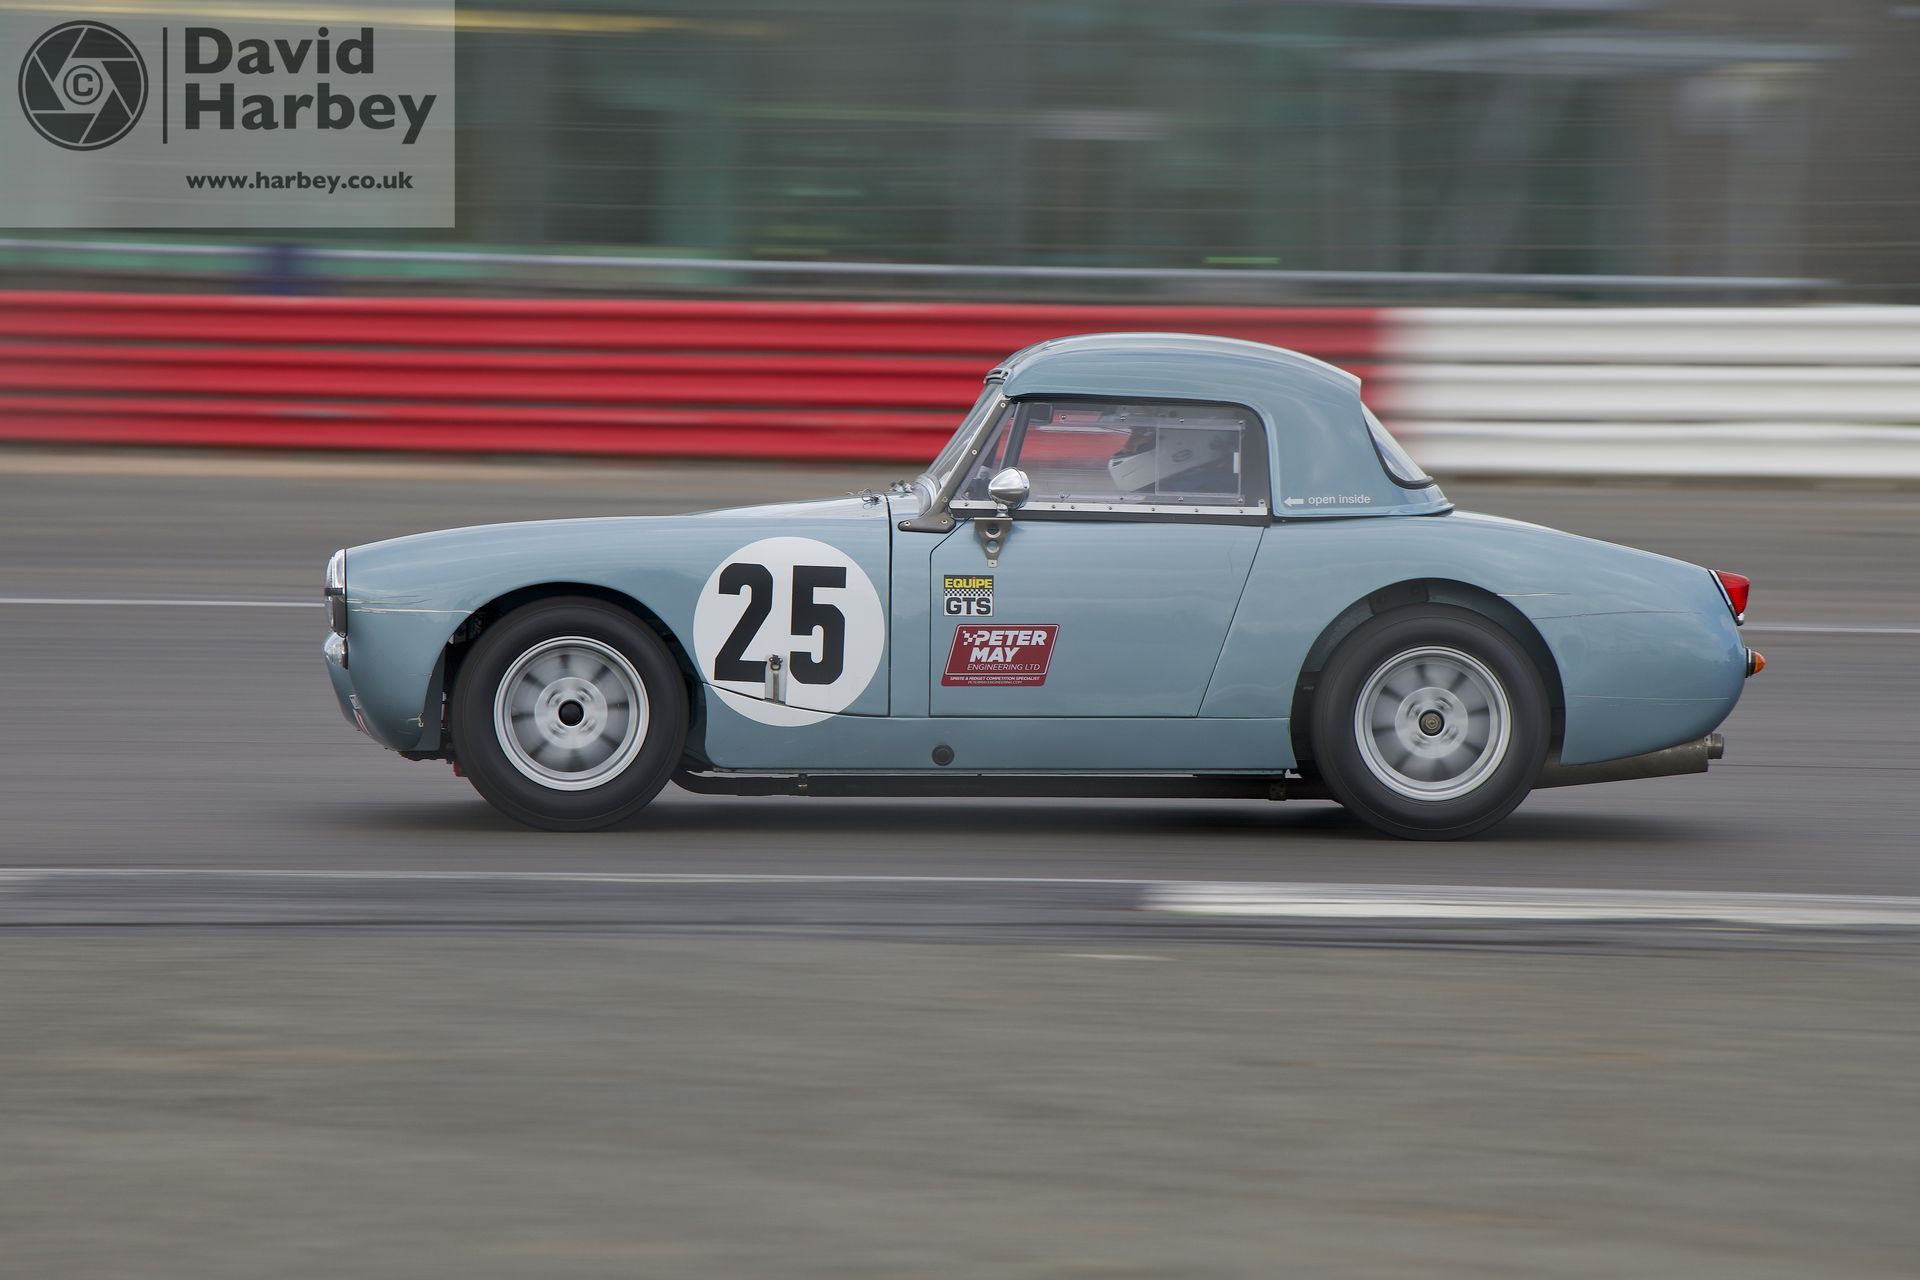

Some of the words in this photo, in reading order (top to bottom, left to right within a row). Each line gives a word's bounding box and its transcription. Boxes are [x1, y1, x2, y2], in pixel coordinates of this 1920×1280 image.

[1308, 496, 1336, 506] open
[1338, 494, 1371, 504] inside
[946, 597, 991, 615] GTS
[714, 562, 847, 685] 25
[974, 630, 1048, 646] PETER
[969, 646, 1021, 663] MAY
[967, 663, 1023, 671] ENGINEERING
[1024, 663, 1040, 671] LTD
